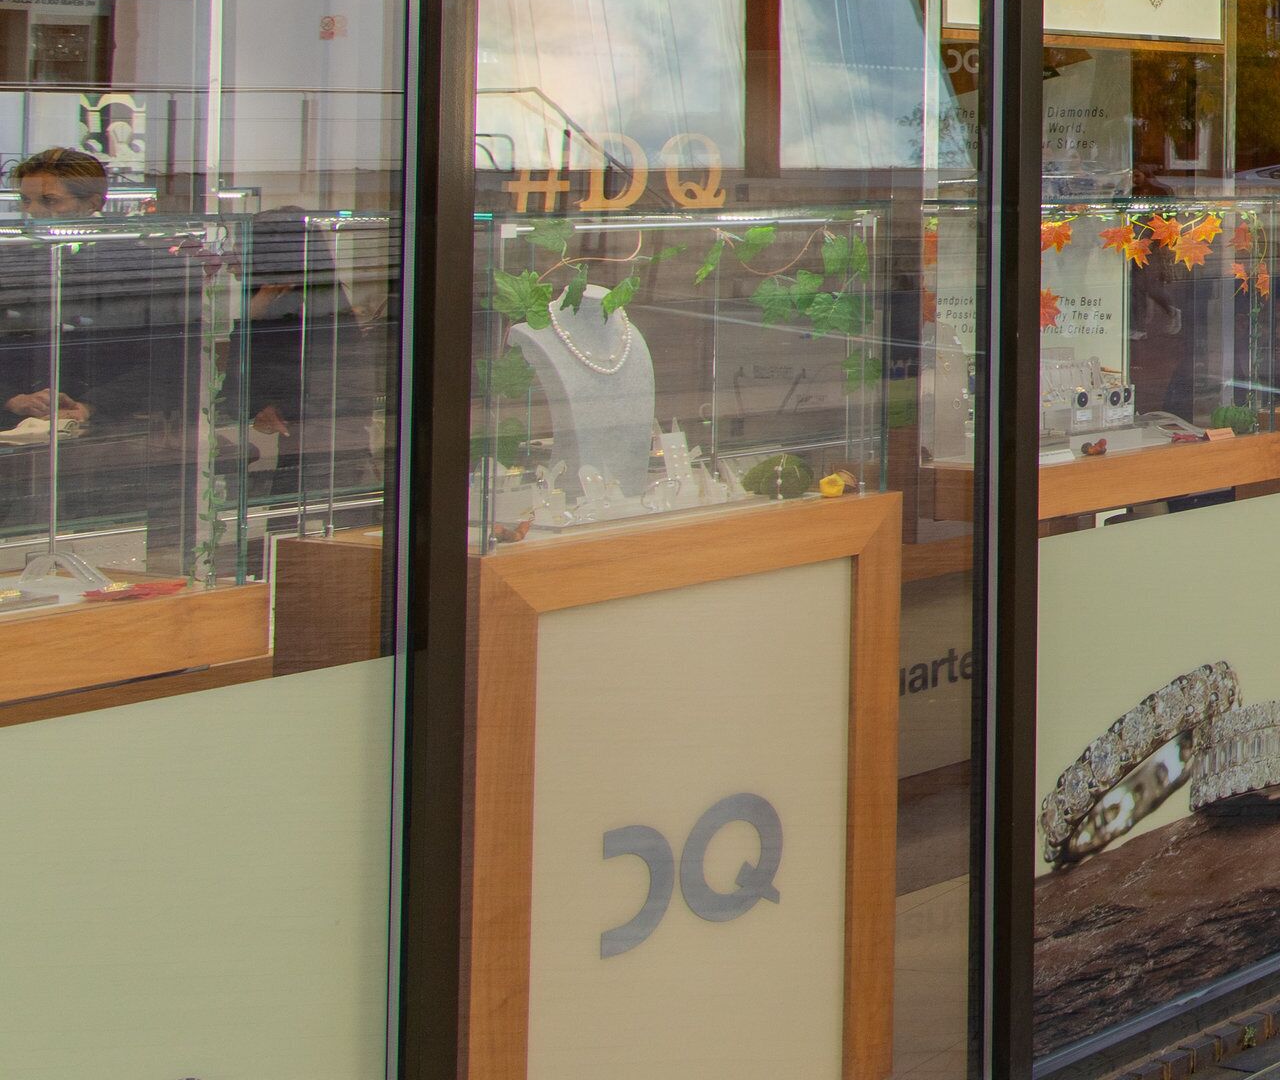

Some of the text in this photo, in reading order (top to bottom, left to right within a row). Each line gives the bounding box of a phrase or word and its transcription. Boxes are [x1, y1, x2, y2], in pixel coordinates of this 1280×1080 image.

[1047, 106, 1108, 119] Diamonds,
[937, 295, 1102, 307] andpick The Best
[1072, 310, 1089, 320] The
[1093, 310, 1112, 320] Few
